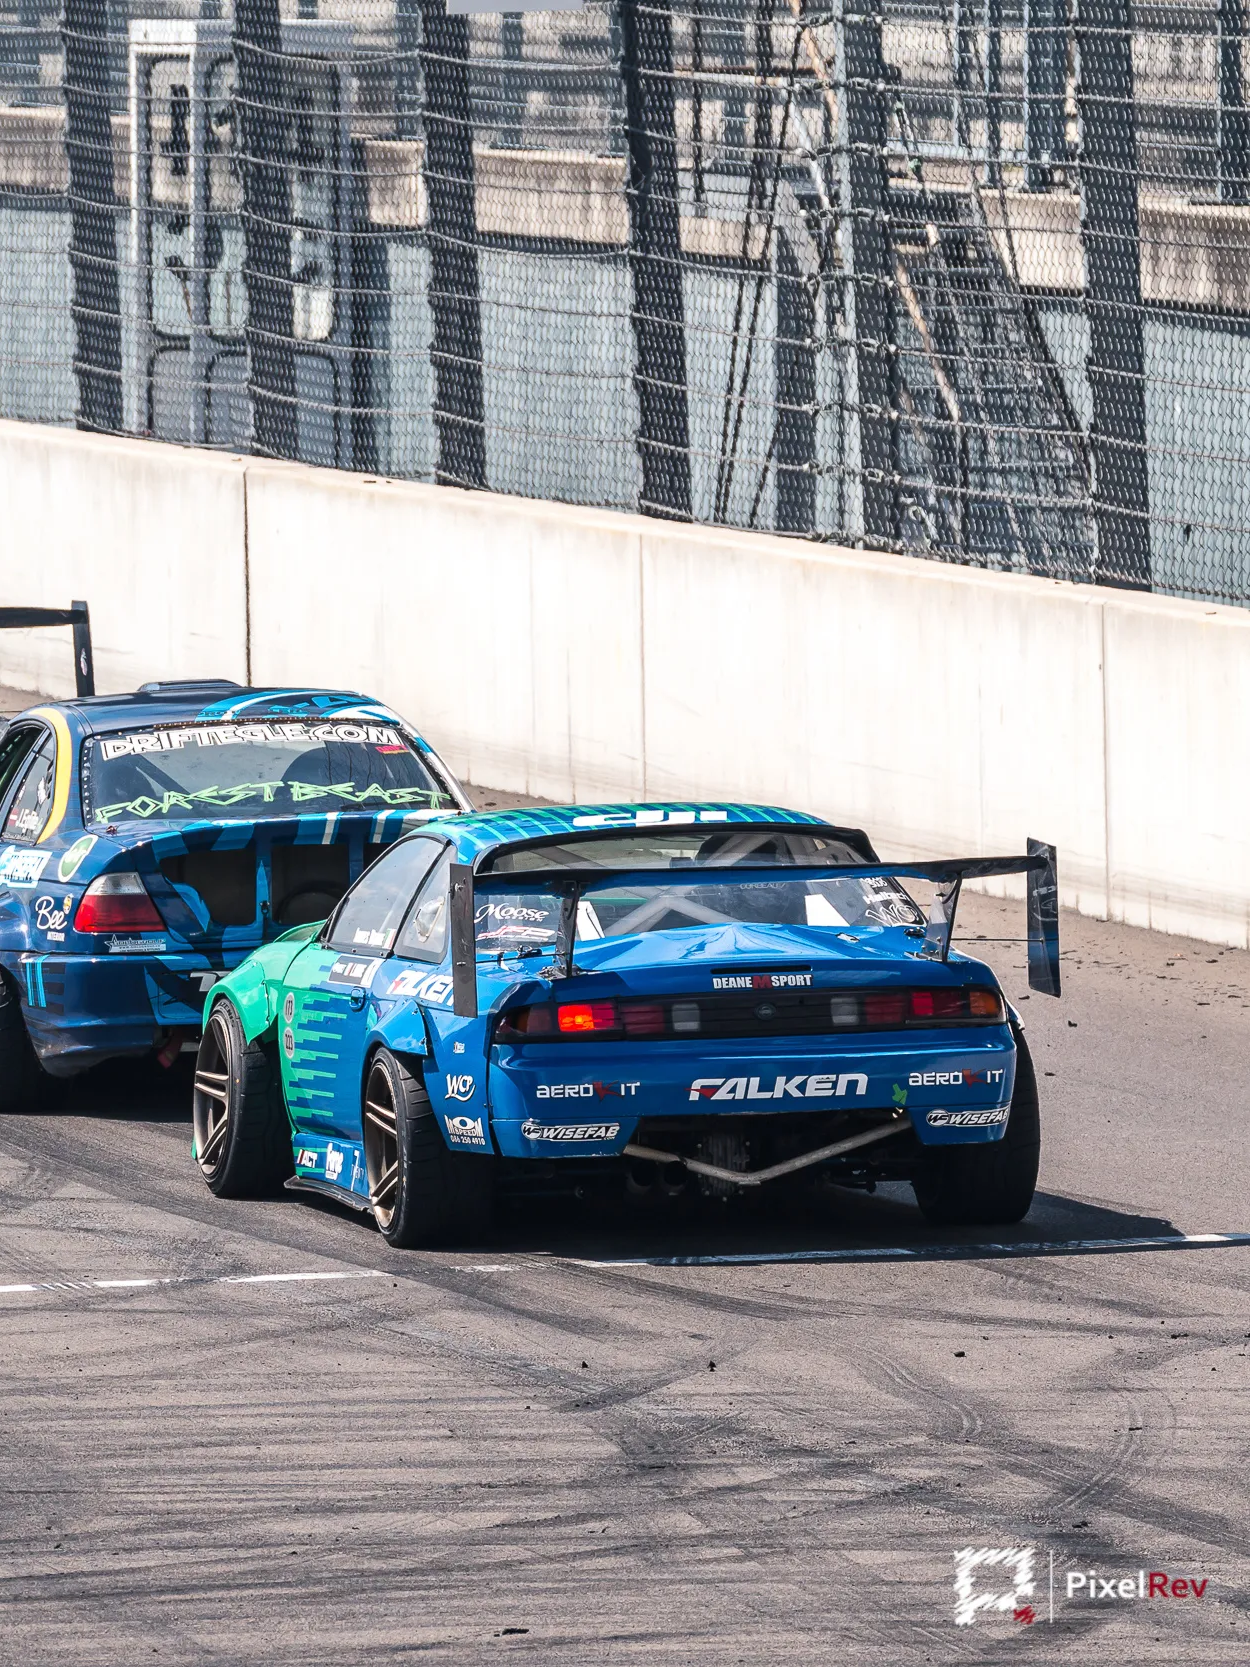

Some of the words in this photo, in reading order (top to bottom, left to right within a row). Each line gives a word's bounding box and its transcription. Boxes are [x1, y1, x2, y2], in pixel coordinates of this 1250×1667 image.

[100, 723, 403, 761] DRIFTEGLE.COM
[35, 896, 68, 930] Bee
[474, 902, 550, 924] Moose
[445, 1074, 475, 1098] WCP
[686, 1073, 869, 1102] FALKEN
[542, 1126, 620, 1139] WISEFAB
